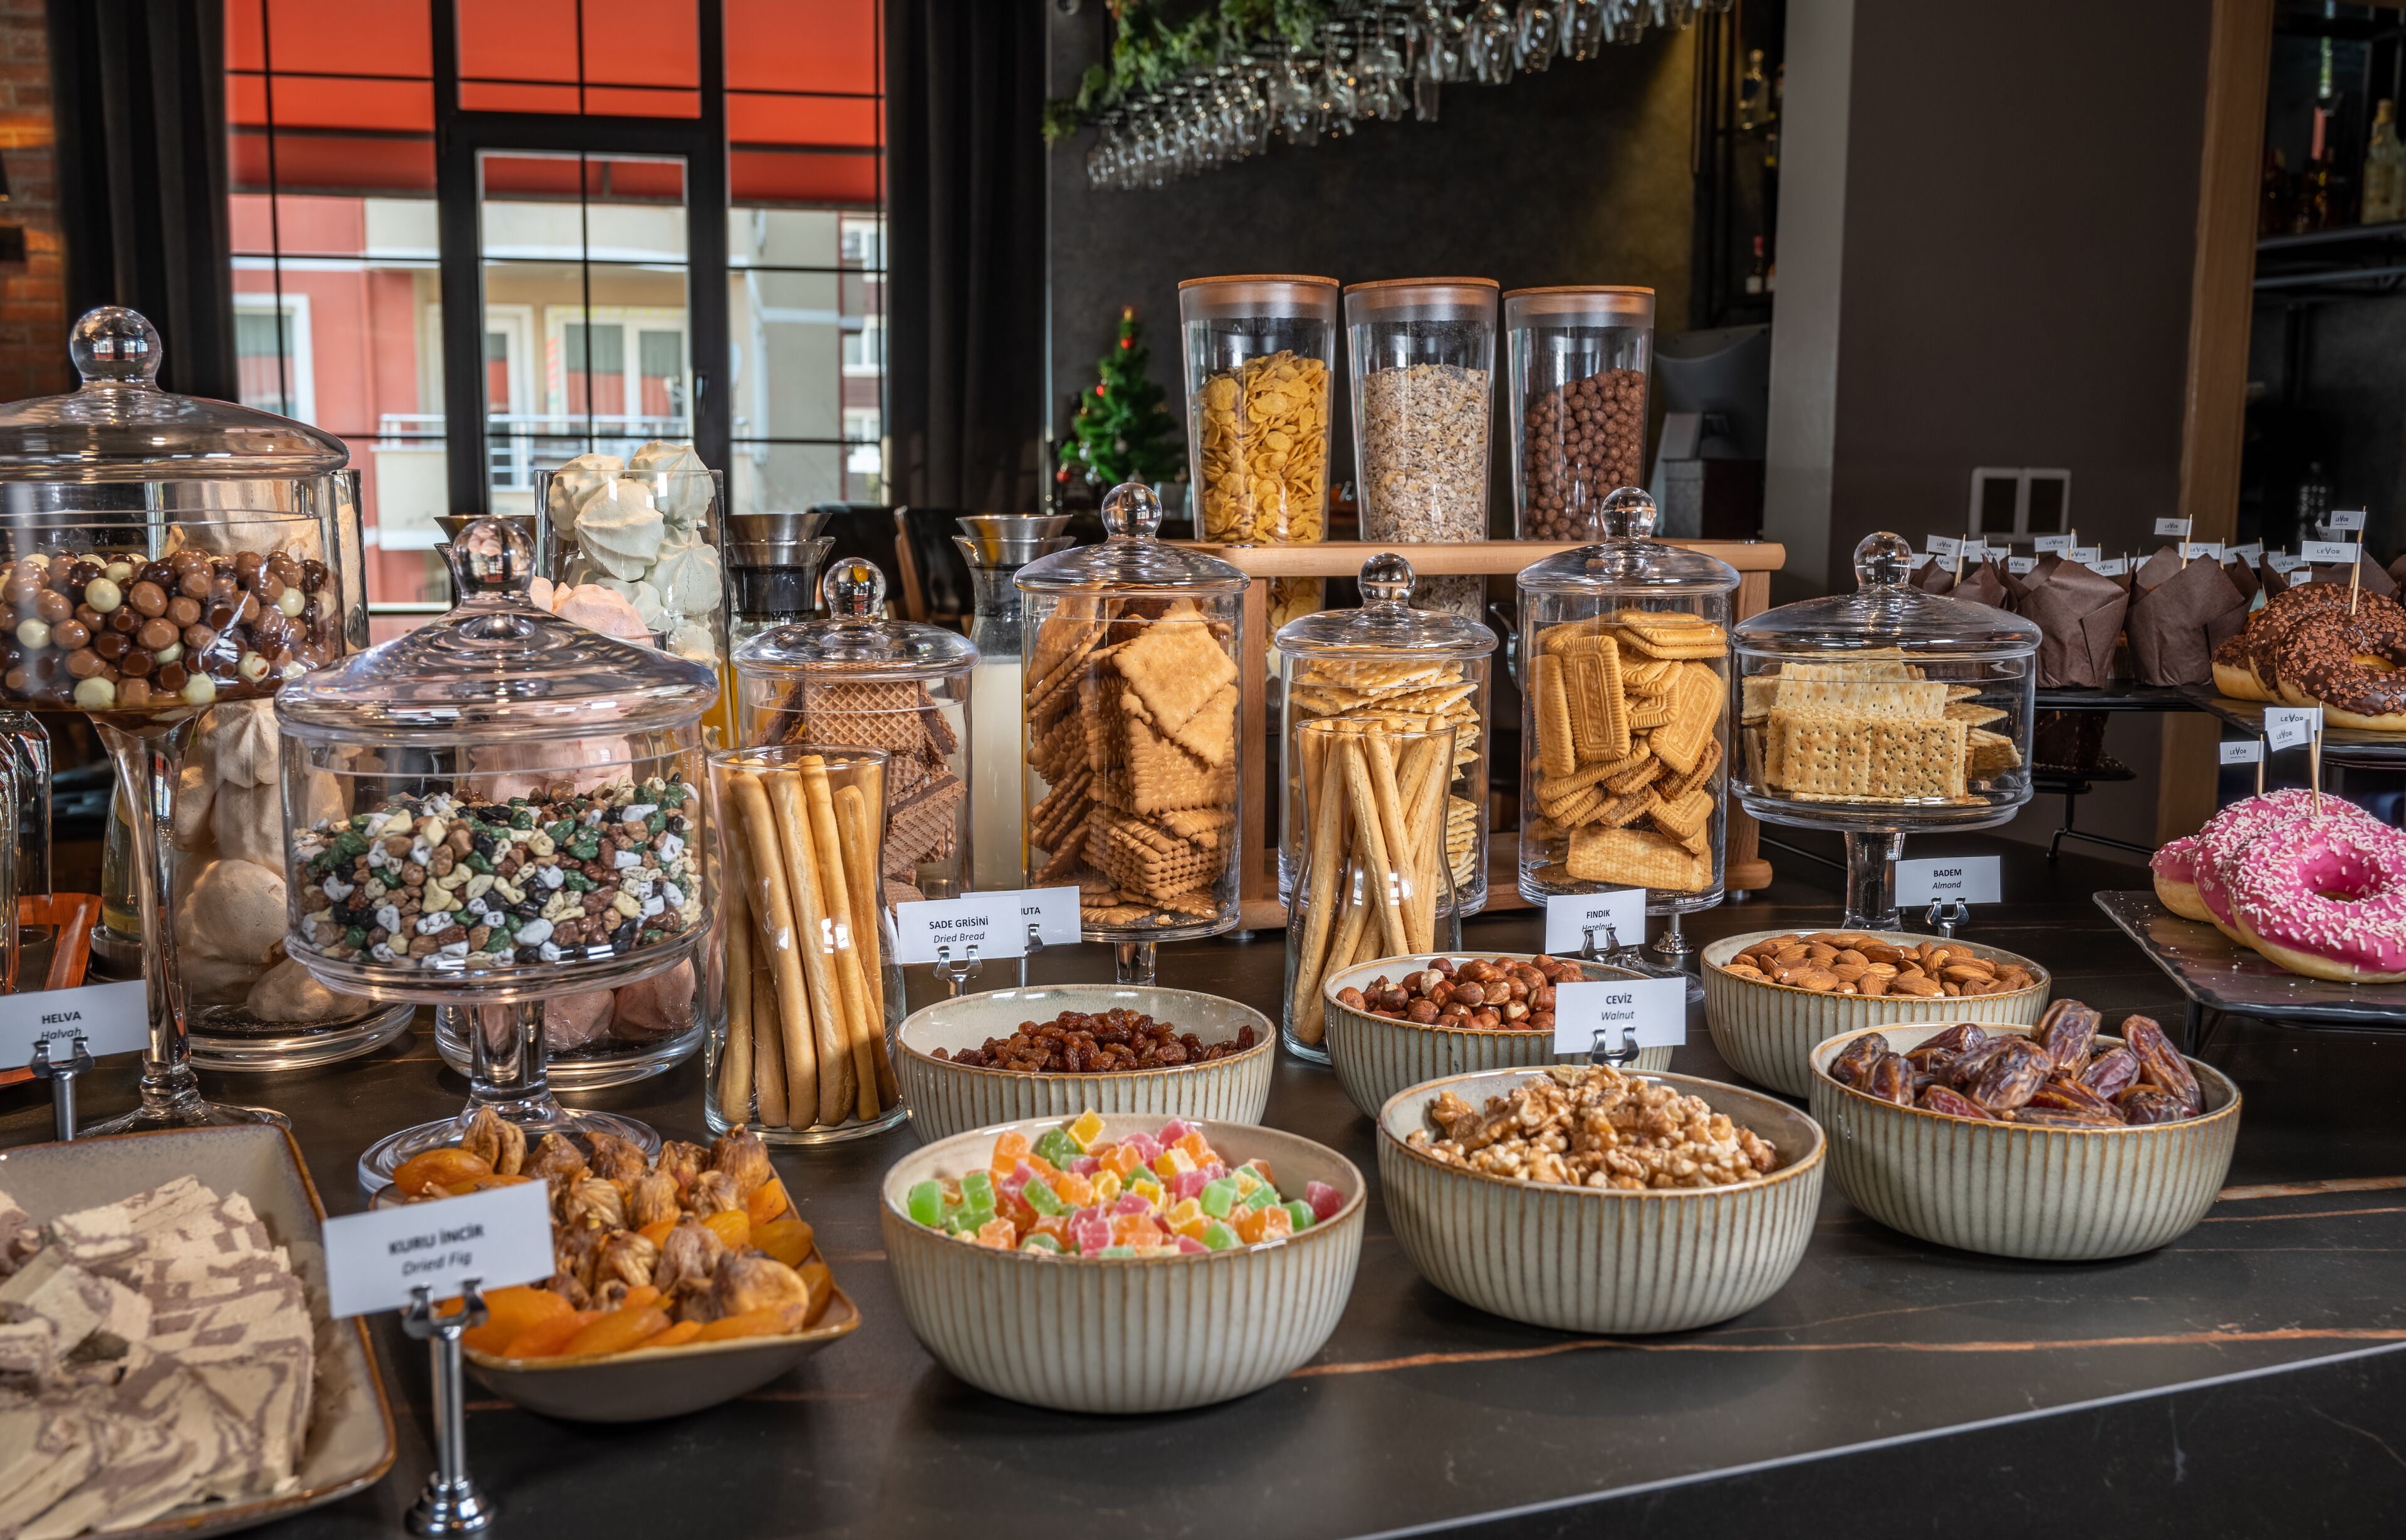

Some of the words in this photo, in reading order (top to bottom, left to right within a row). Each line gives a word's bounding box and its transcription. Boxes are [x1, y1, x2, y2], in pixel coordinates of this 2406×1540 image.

[2335, 514, 2349, 523] LEVOR
[2317, 546, 2340, 554] LEVOR
[2281, 713, 2303, 722] LEVOR
[2276, 729, 2293, 740] LEVOR
[2230, 747, 2247, 756] LEVOR
[1934, 868, 1962, 877] BADEM
[1932, 880, 1962, 890] Almond
[1586, 909, 1610, 919] FINDIK
[929, 920, 953, 930] SADE
[955, 915, 989, 928] GRİSİNİ
[934, 932, 957, 944] Dried
[959, 931, 985, 942] Bread
[1606, 992, 1632, 1004] CEVİZ
[42, 1011, 81, 1024] HELVA
[1601, 1011, 1635, 1021] Walnut
[41, 1027, 81, 1040] Halvah
[388, 1234, 436, 1256] KURU
[439, 1222, 484, 1246] İNCİR
[402, 1256, 445, 1277] Dried
[449, 1250, 473, 1268] Fig
